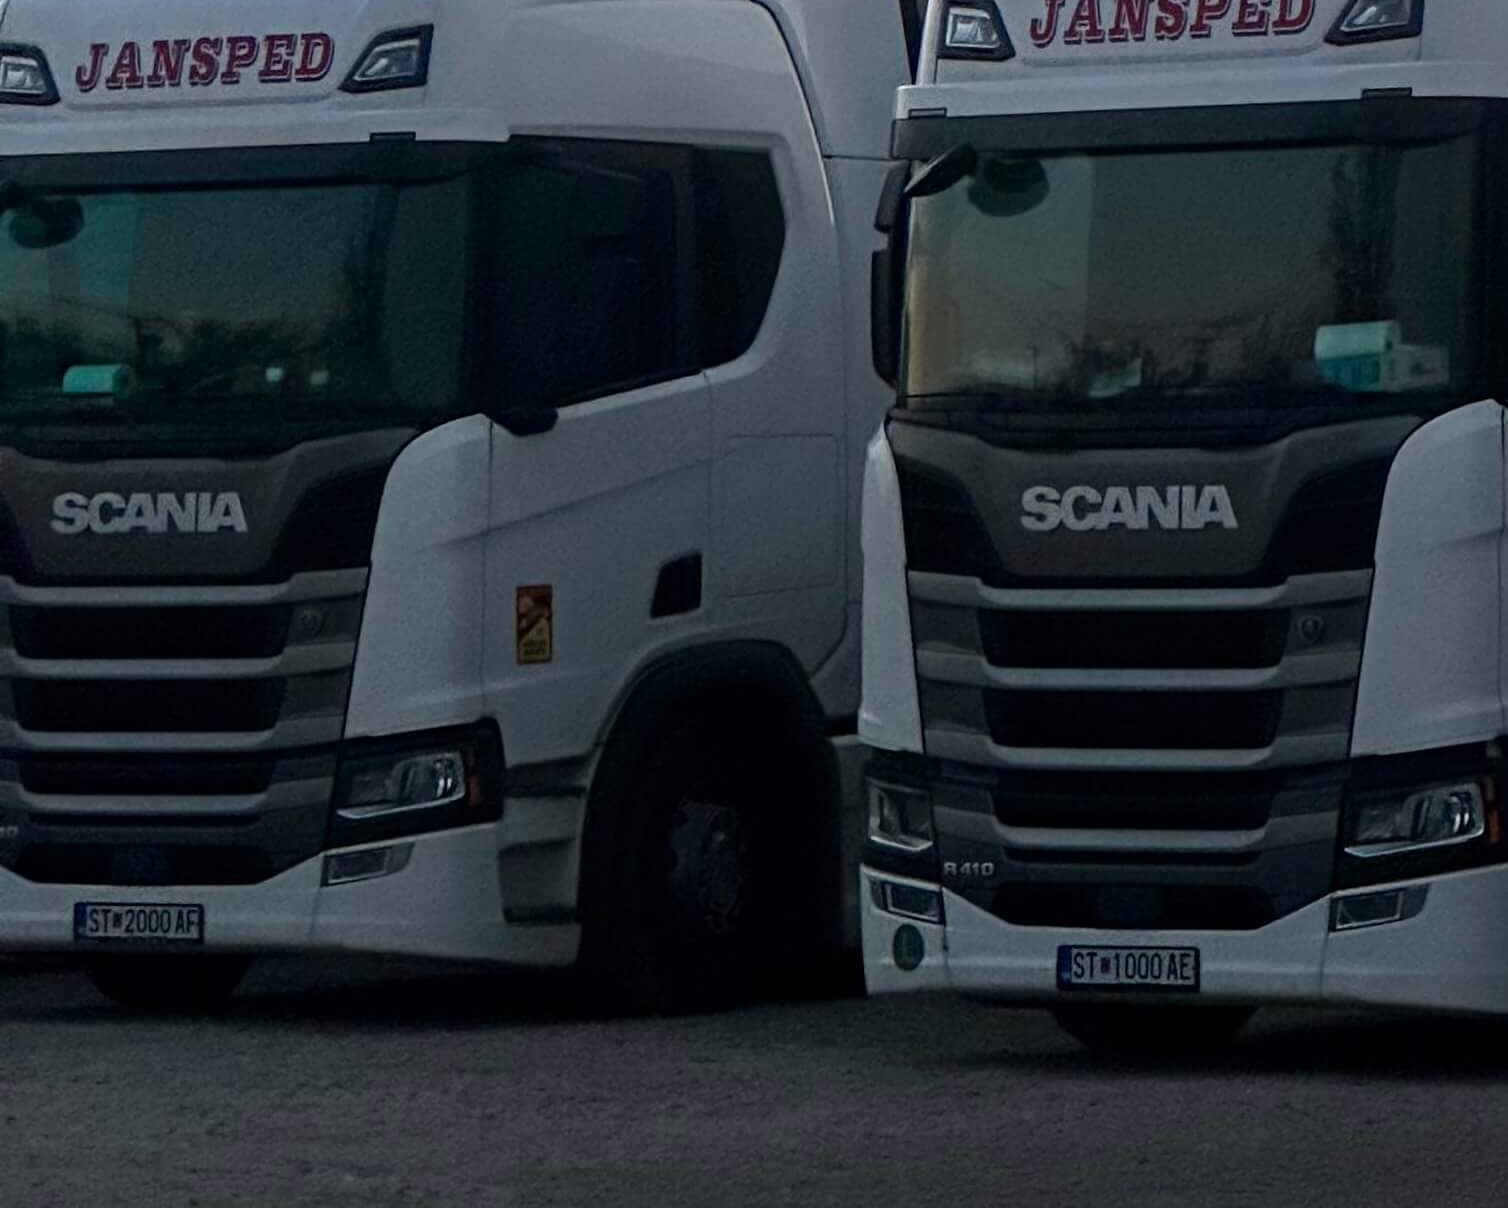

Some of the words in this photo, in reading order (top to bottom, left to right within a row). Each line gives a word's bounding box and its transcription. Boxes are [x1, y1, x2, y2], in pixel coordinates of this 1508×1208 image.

[76, 32, 335, 92] JANSPED
[50, 490, 249, 534] SCANIA
[1020, 484, 1239, 532] SCANIA
[88, 909, 112, 933] ST
[125, 909, 171, 934] 2000
[1073, 952, 1098, 979] ST
[1113, 953, 1162, 980] 1000
[1167, 953, 1192, 981] AE
